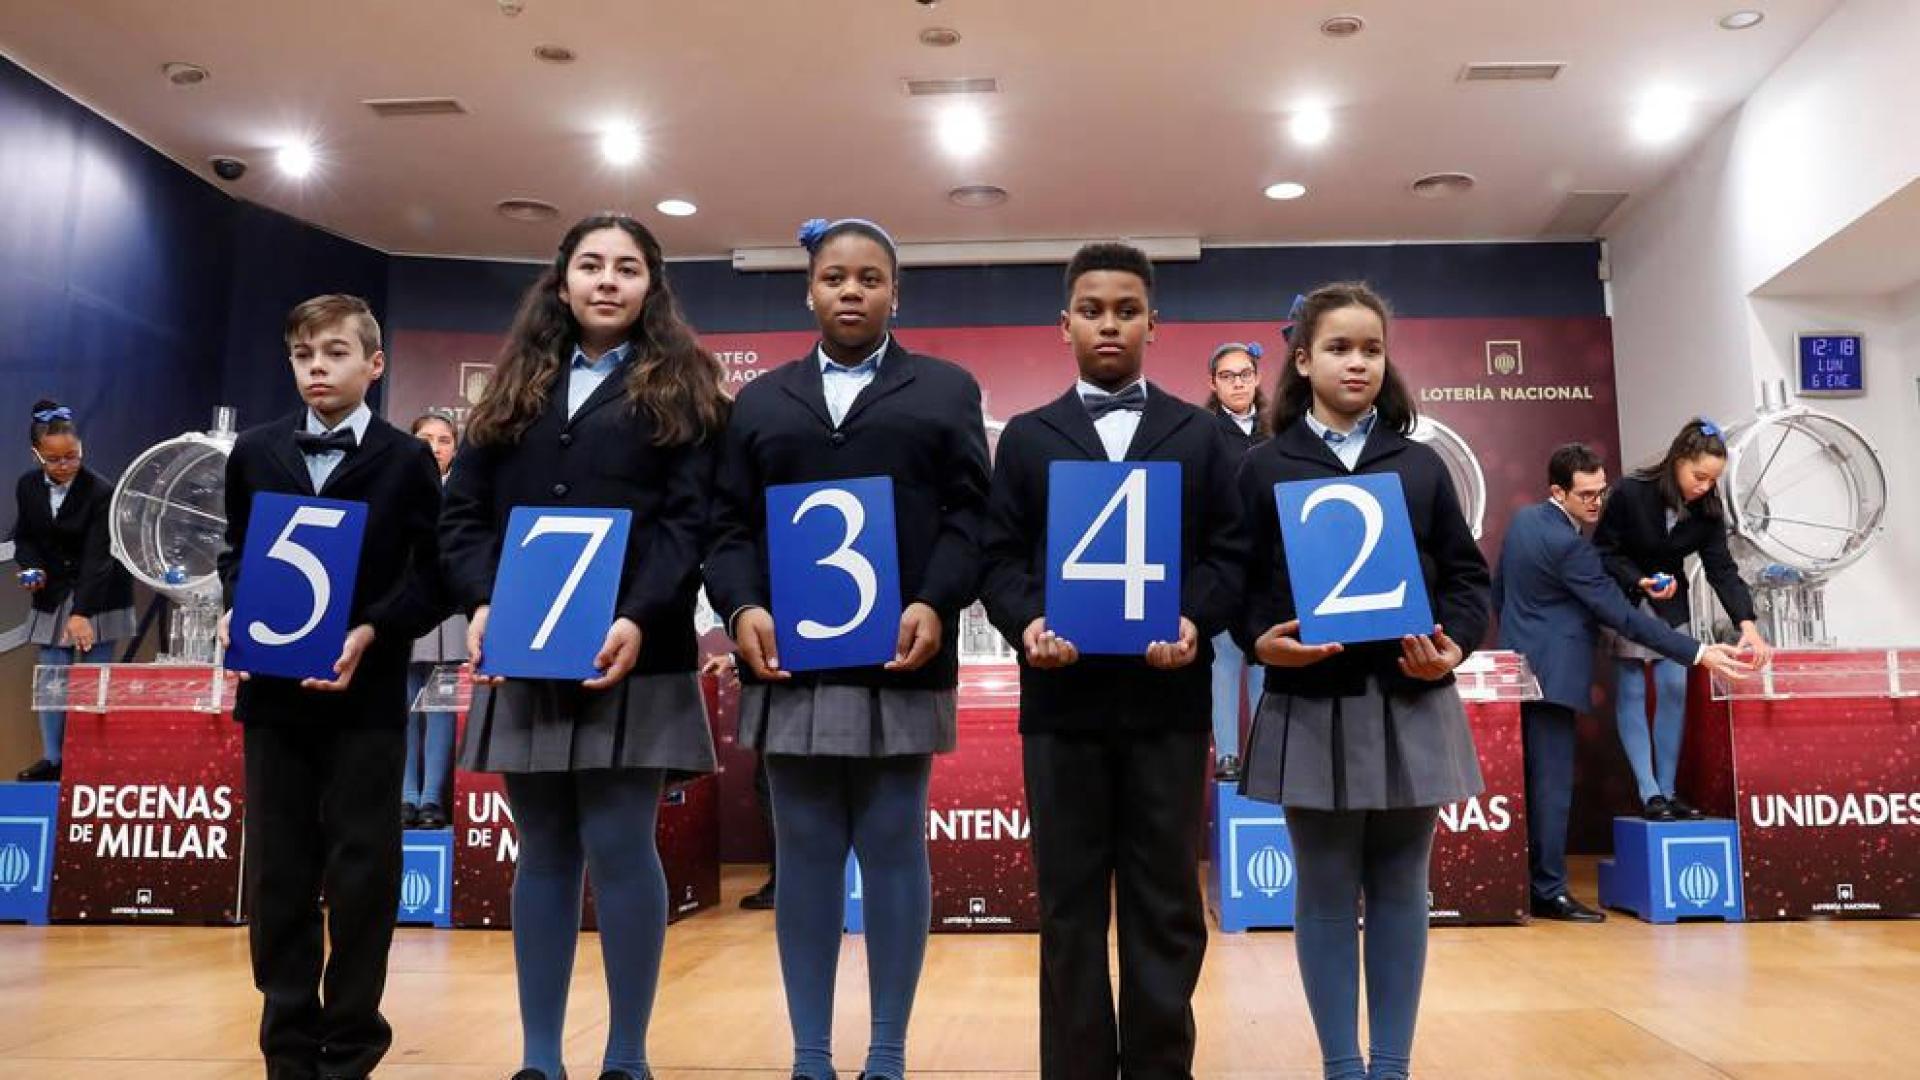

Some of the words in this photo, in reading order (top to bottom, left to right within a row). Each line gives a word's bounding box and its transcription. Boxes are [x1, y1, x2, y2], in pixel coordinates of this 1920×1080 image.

[713, 350, 759, 365] TEO
[1812, 338, 1855, 356] 12:18
[1421, 383, 1494, 401] LOTERÍA
[1501, 386, 1593, 400] NACIONAL
[1062, 468, 1166, 621] 4
[1300, 483, 1407, 616] 2
[249, 506, 346, 646] 5
[792, 488, 877, 639] 3
[521, 515, 614, 650] 7
[71, 784, 232, 820] DECENAS
[468, 791, 515, 823] UN
[1438, 794, 1512, 832] NAS
[1750, 792, 1920, 827] UNIDADES
[69, 823, 93, 842] DE
[96, 823, 228, 860] MILLAR
[468, 827, 492, 848] DE
[925, 807, 1031, 841] NTEN
